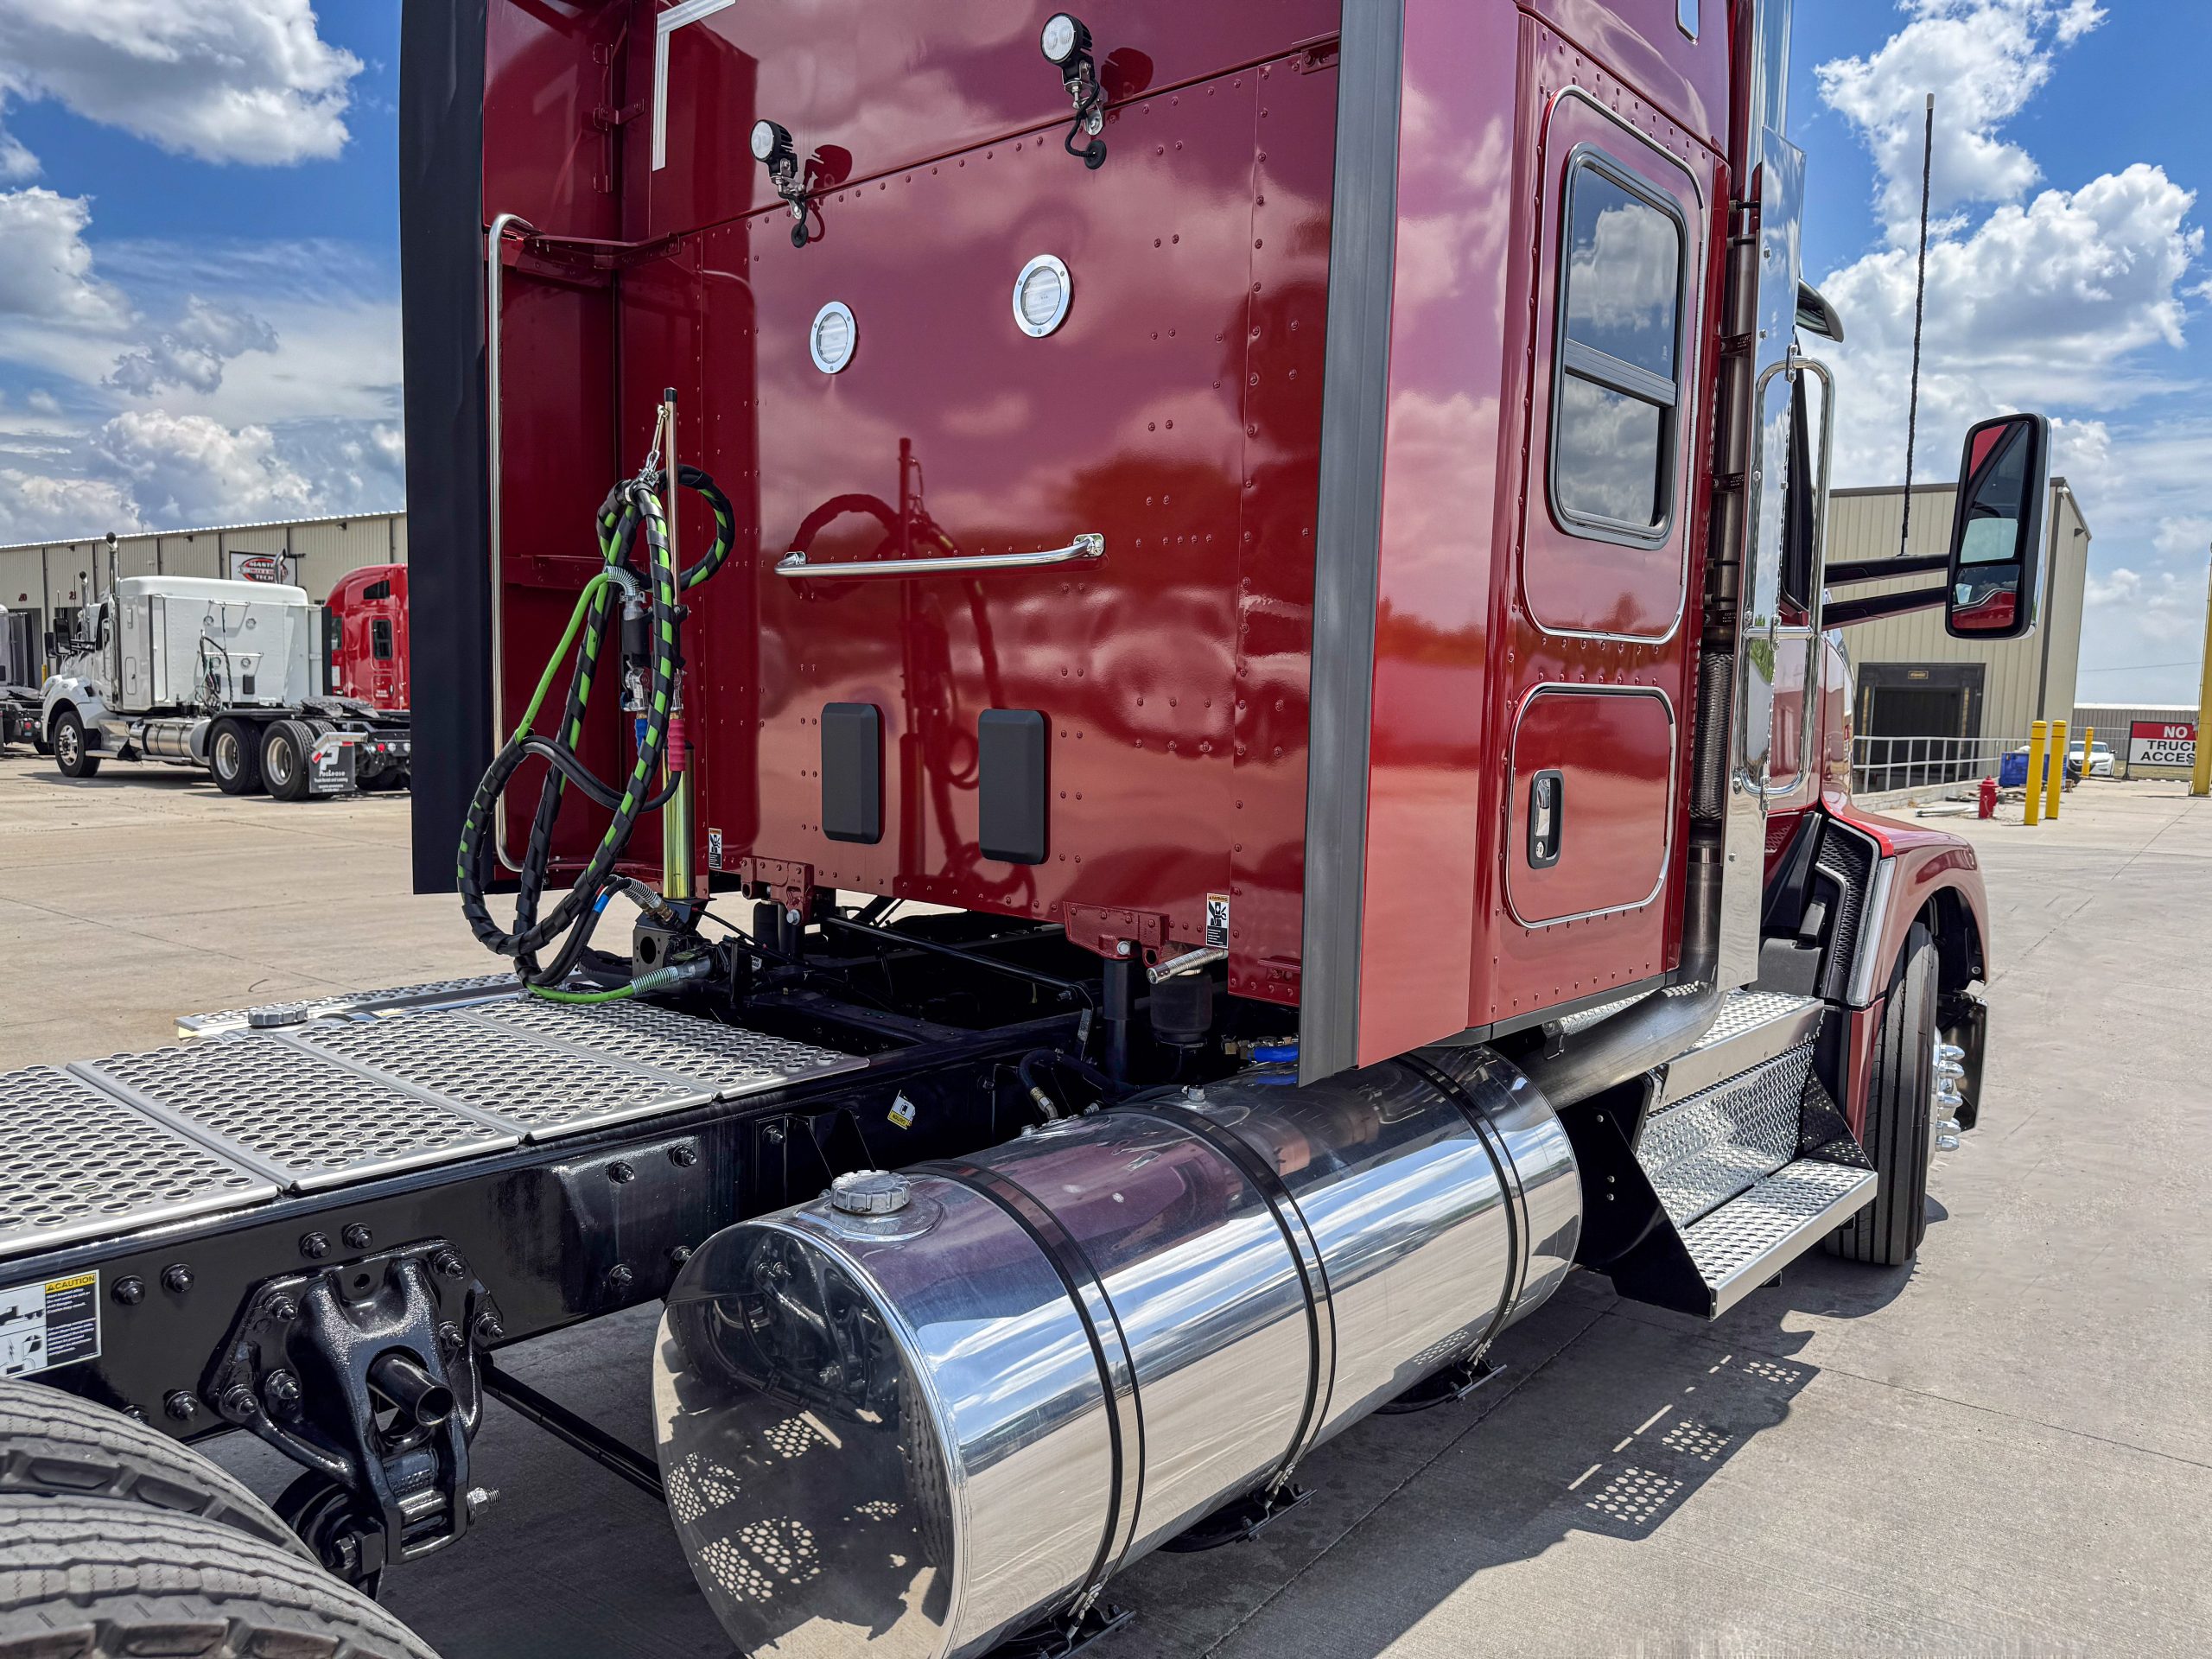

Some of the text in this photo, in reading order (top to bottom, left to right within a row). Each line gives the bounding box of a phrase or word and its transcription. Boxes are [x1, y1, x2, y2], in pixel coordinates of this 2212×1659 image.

[2163, 726, 2188, 739] NO
[2140, 752, 2196, 763] ACCES
[55, 1275, 95, 1289] CAUTION
